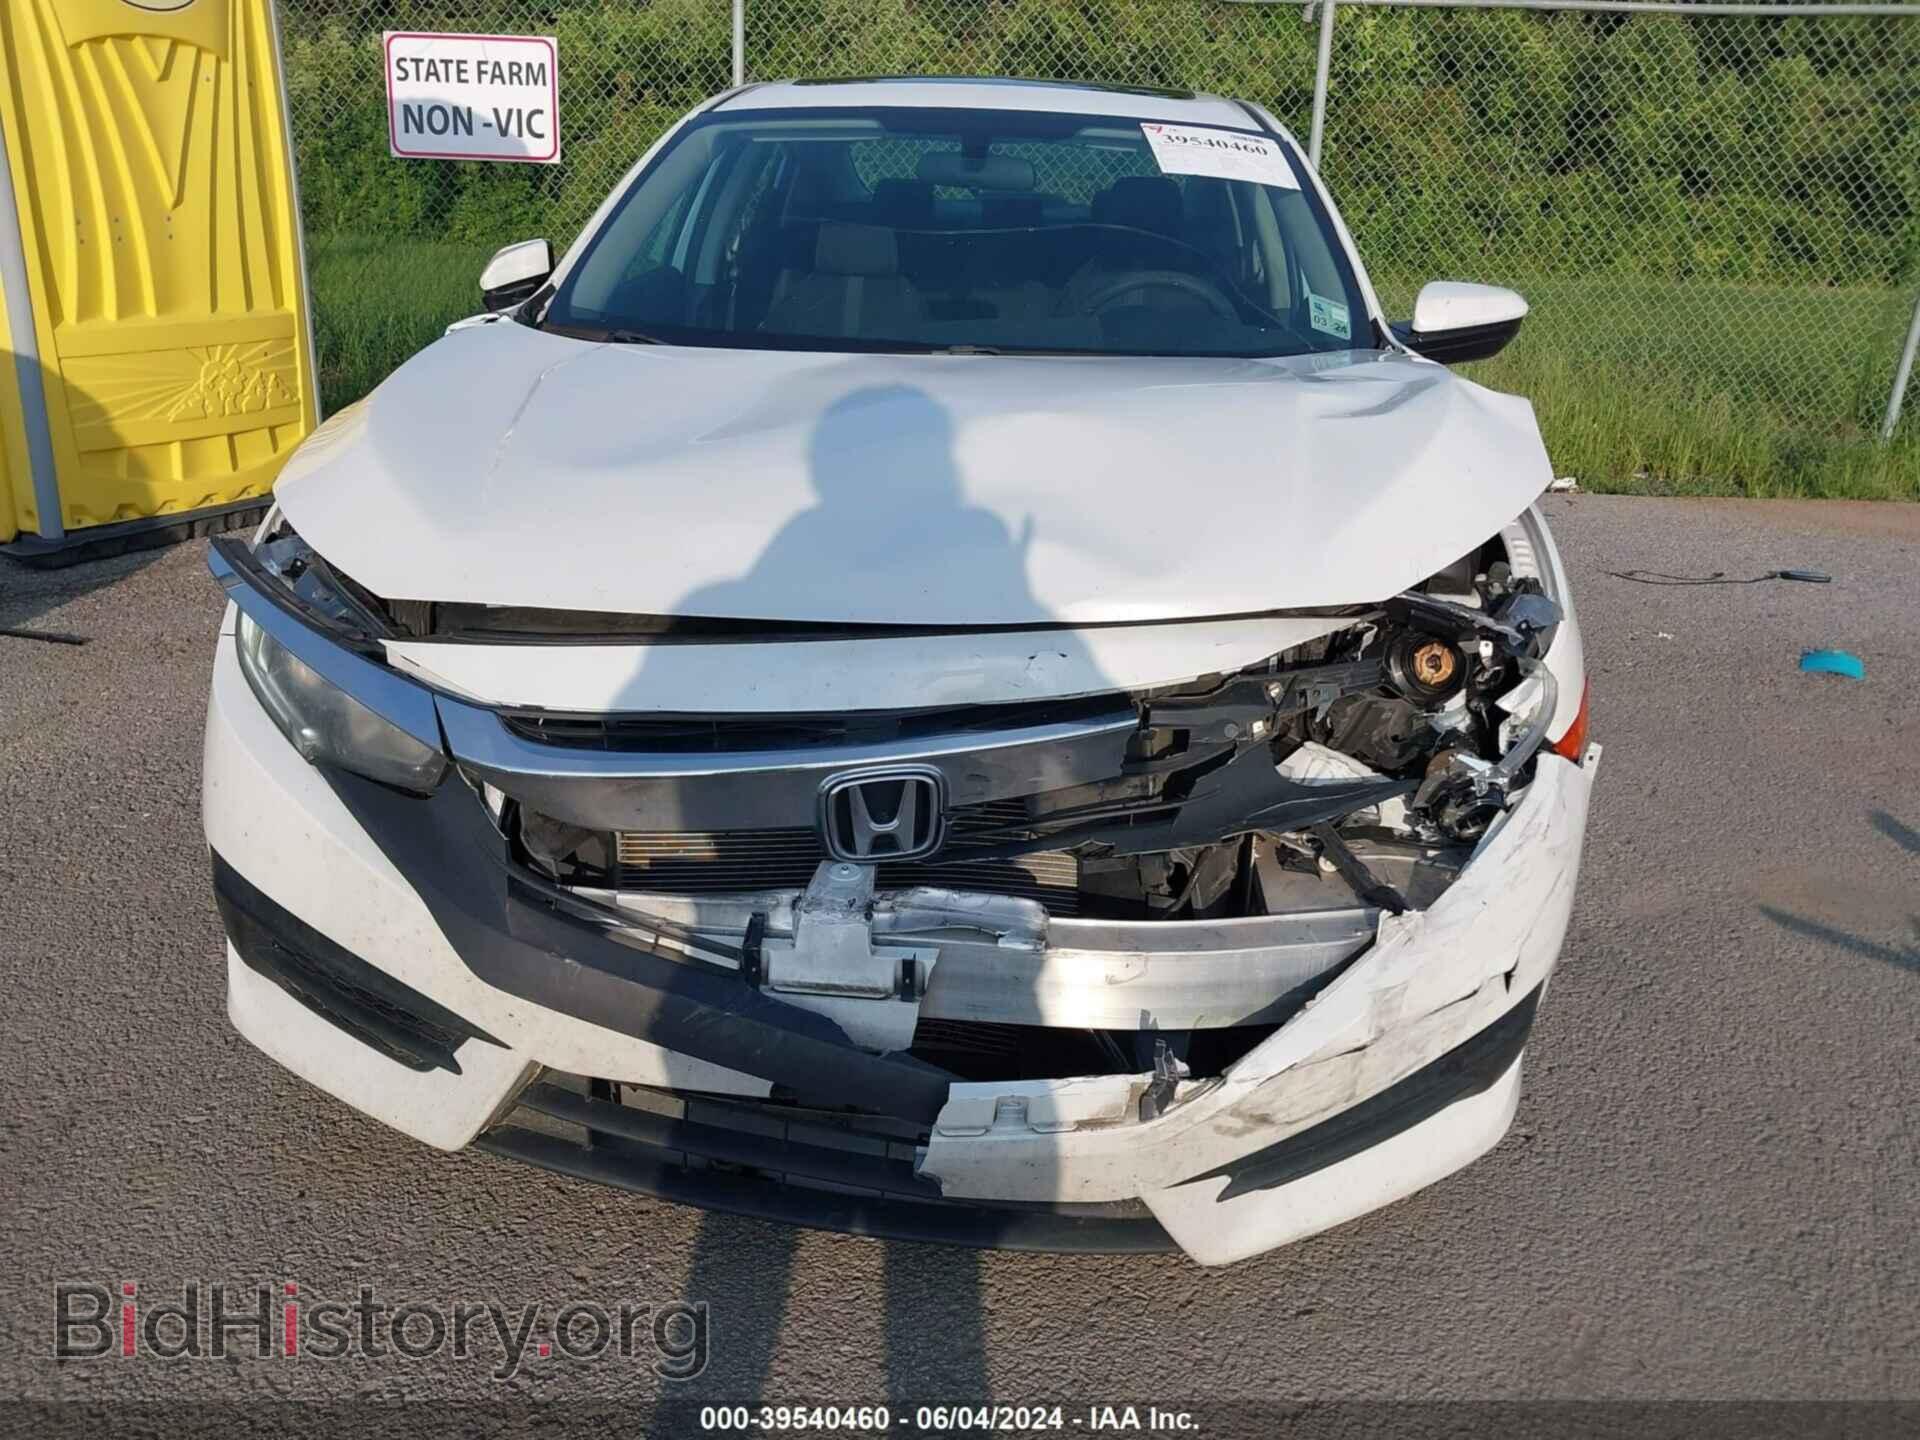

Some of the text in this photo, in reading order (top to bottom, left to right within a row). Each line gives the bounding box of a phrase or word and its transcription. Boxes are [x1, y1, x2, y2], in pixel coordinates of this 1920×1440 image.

[396, 57, 547, 87] STATE FARM
[402, 104, 474, 136] NON
[1163, 134, 1268, 155] 39540460
